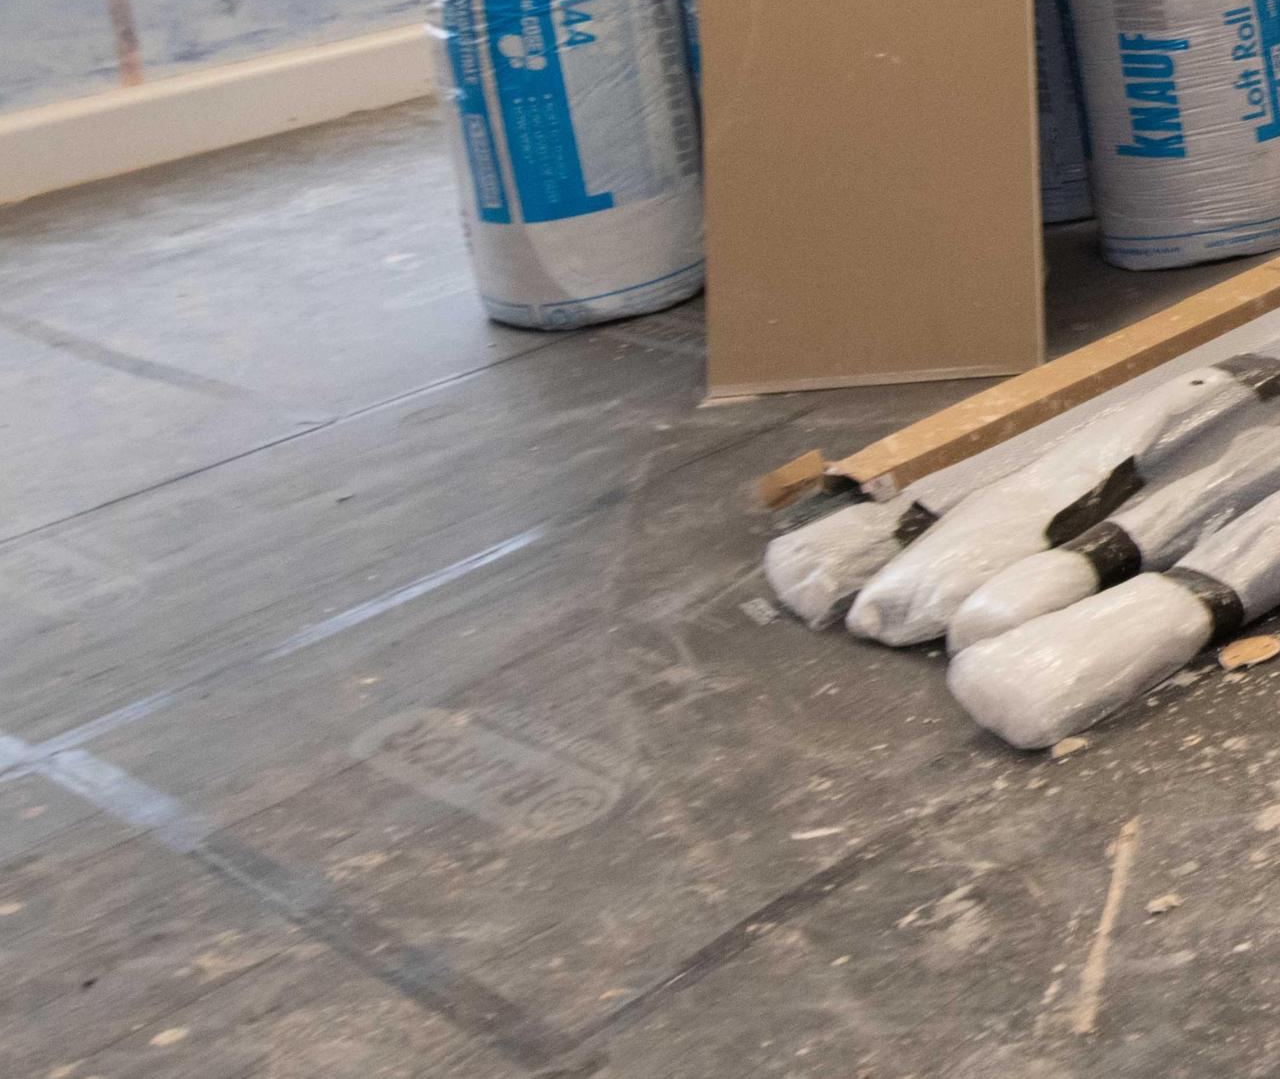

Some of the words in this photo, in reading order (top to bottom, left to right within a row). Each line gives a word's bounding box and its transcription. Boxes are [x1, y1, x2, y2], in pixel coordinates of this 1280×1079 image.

[562, 8, 597, 47] 44
[1223, 6, 1257, 61] Roll
[1115, 33, 1190, 159] KNAUF
[1232, 70, 1266, 121] Loft
